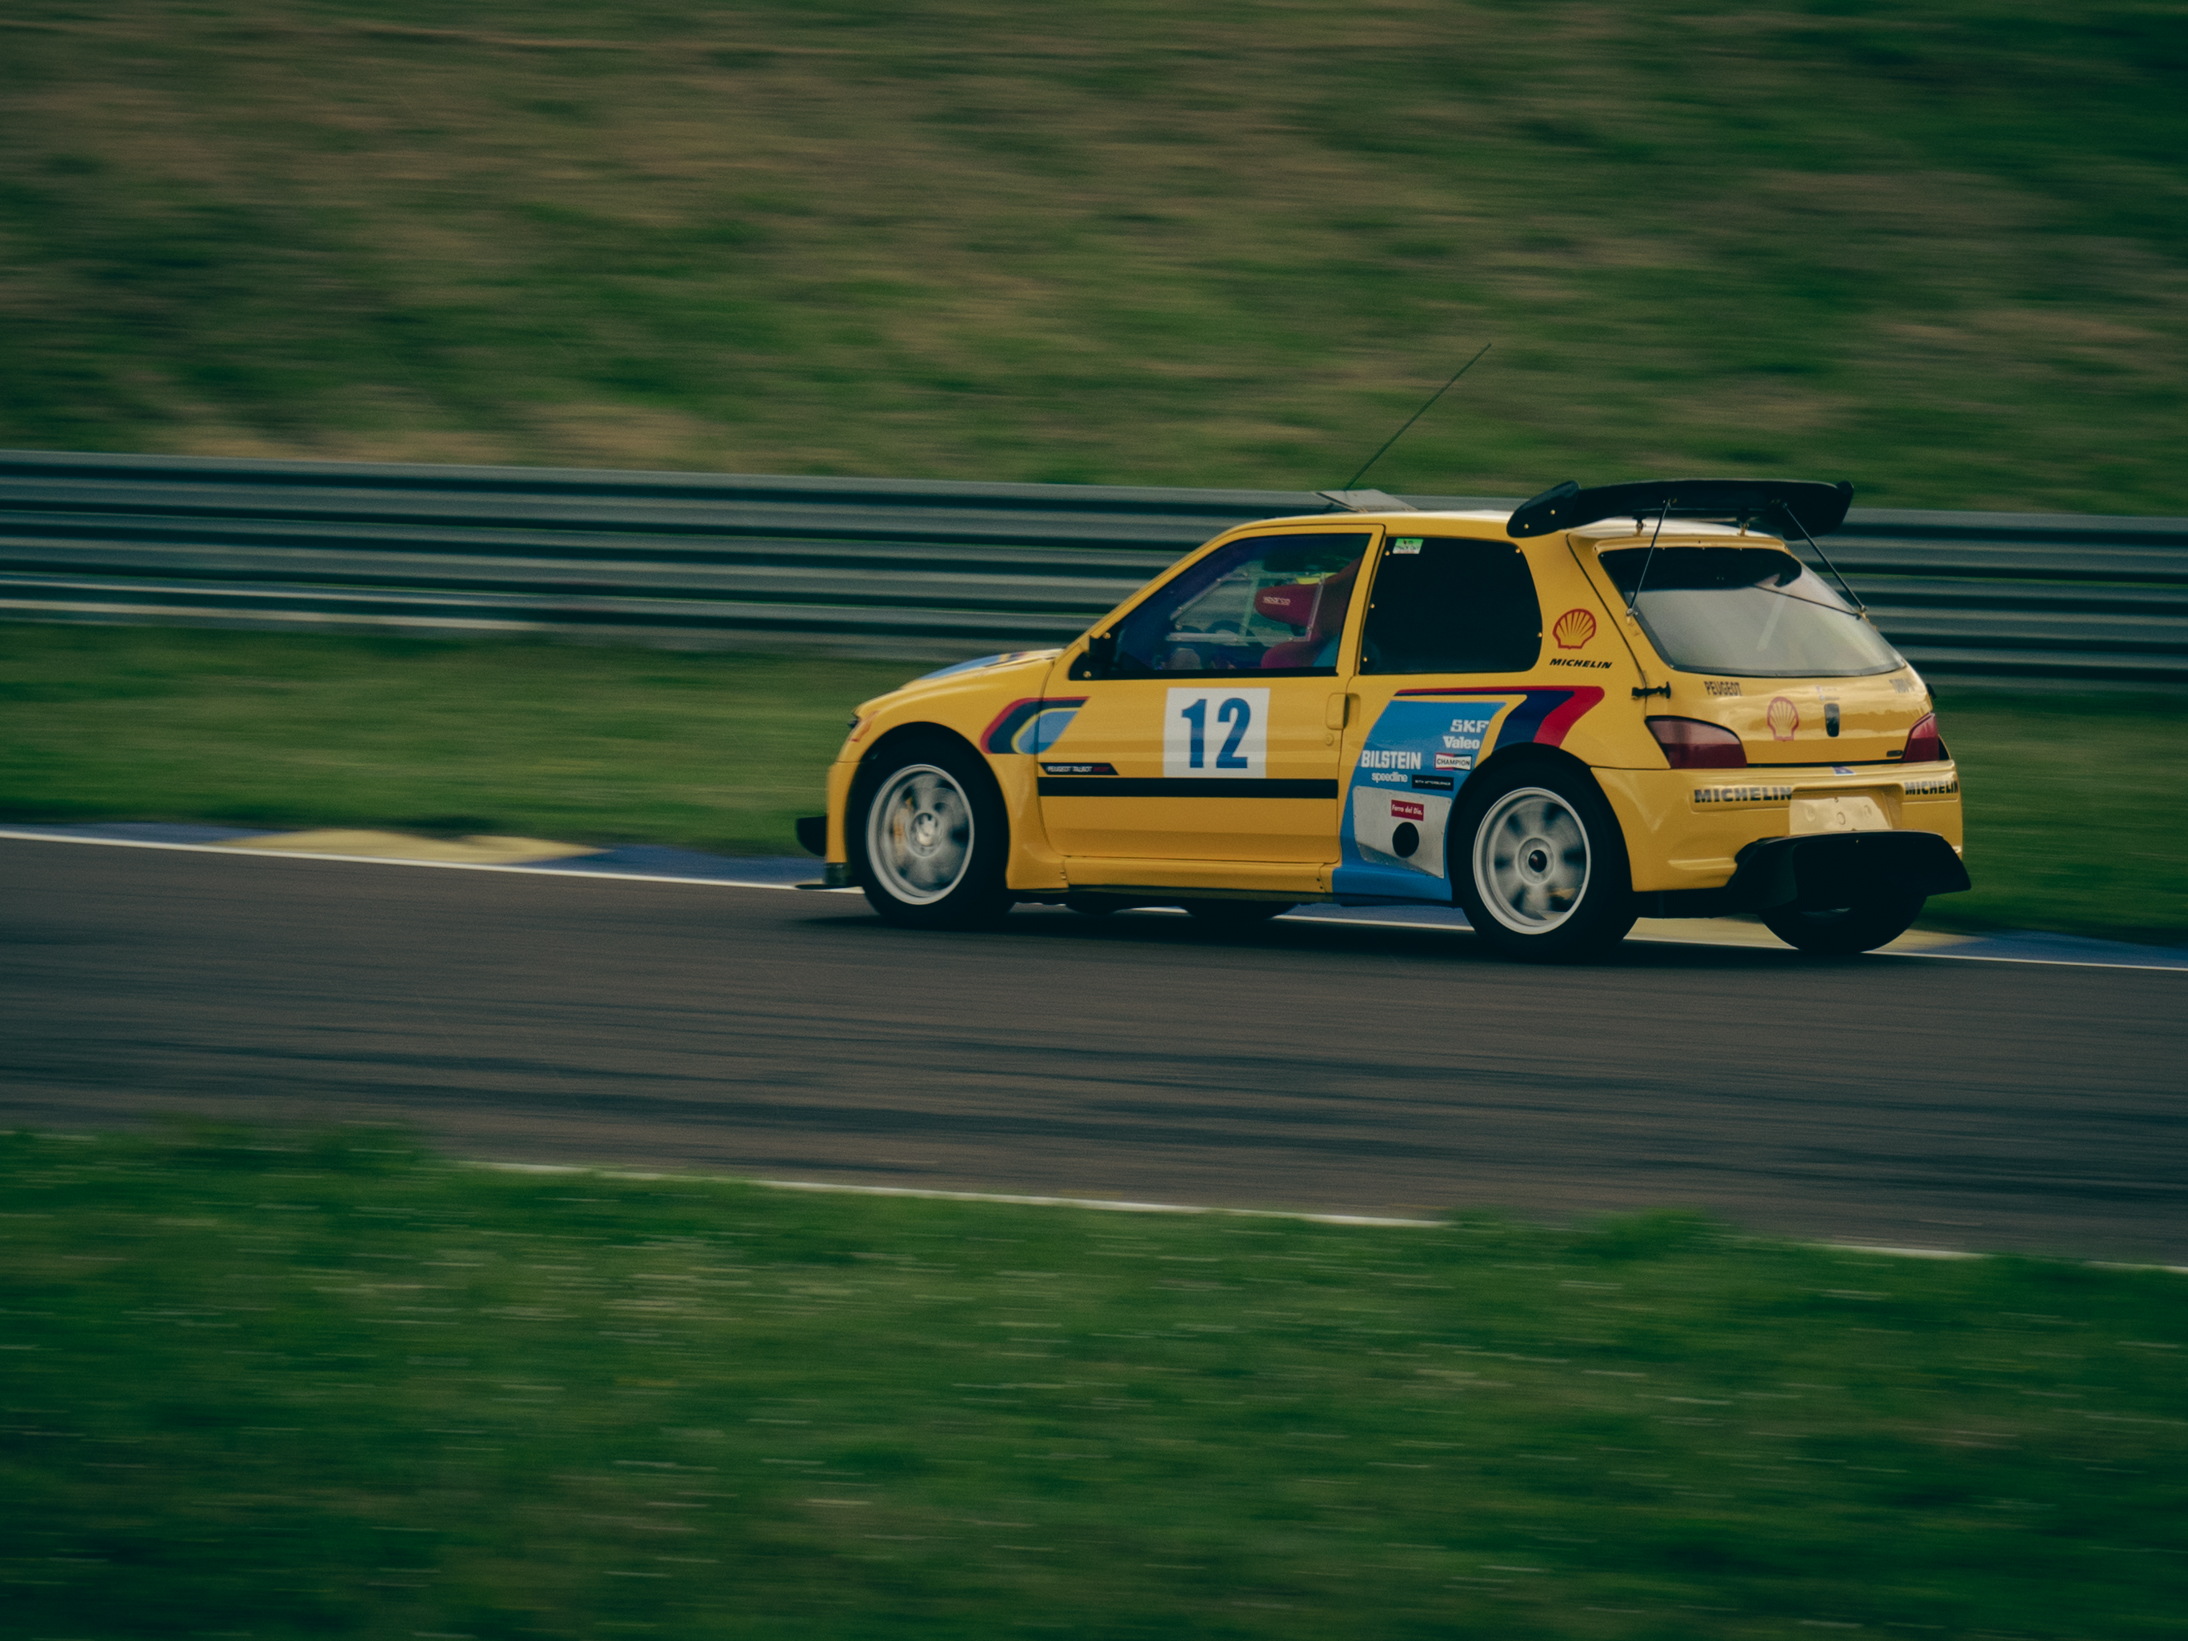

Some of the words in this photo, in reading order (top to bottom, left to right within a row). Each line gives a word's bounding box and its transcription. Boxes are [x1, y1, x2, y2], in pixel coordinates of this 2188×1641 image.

[1549, 658, 1613, 669] MICHELIN
[1704, 681, 1742, 696] PEUGEOT
[1181, 697, 1251, 769] 12
[1450, 719, 1490, 733] SKF
[1443, 735, 1480, 749] Valeo
[1360, 749, 1421, 770] BILSTEIN
[1436, 757, 1470, 767] CHAMPION
[1694, 787, 1792, 803] MICHELIN
[1904, 781, 1958, 795] MICHELIN
